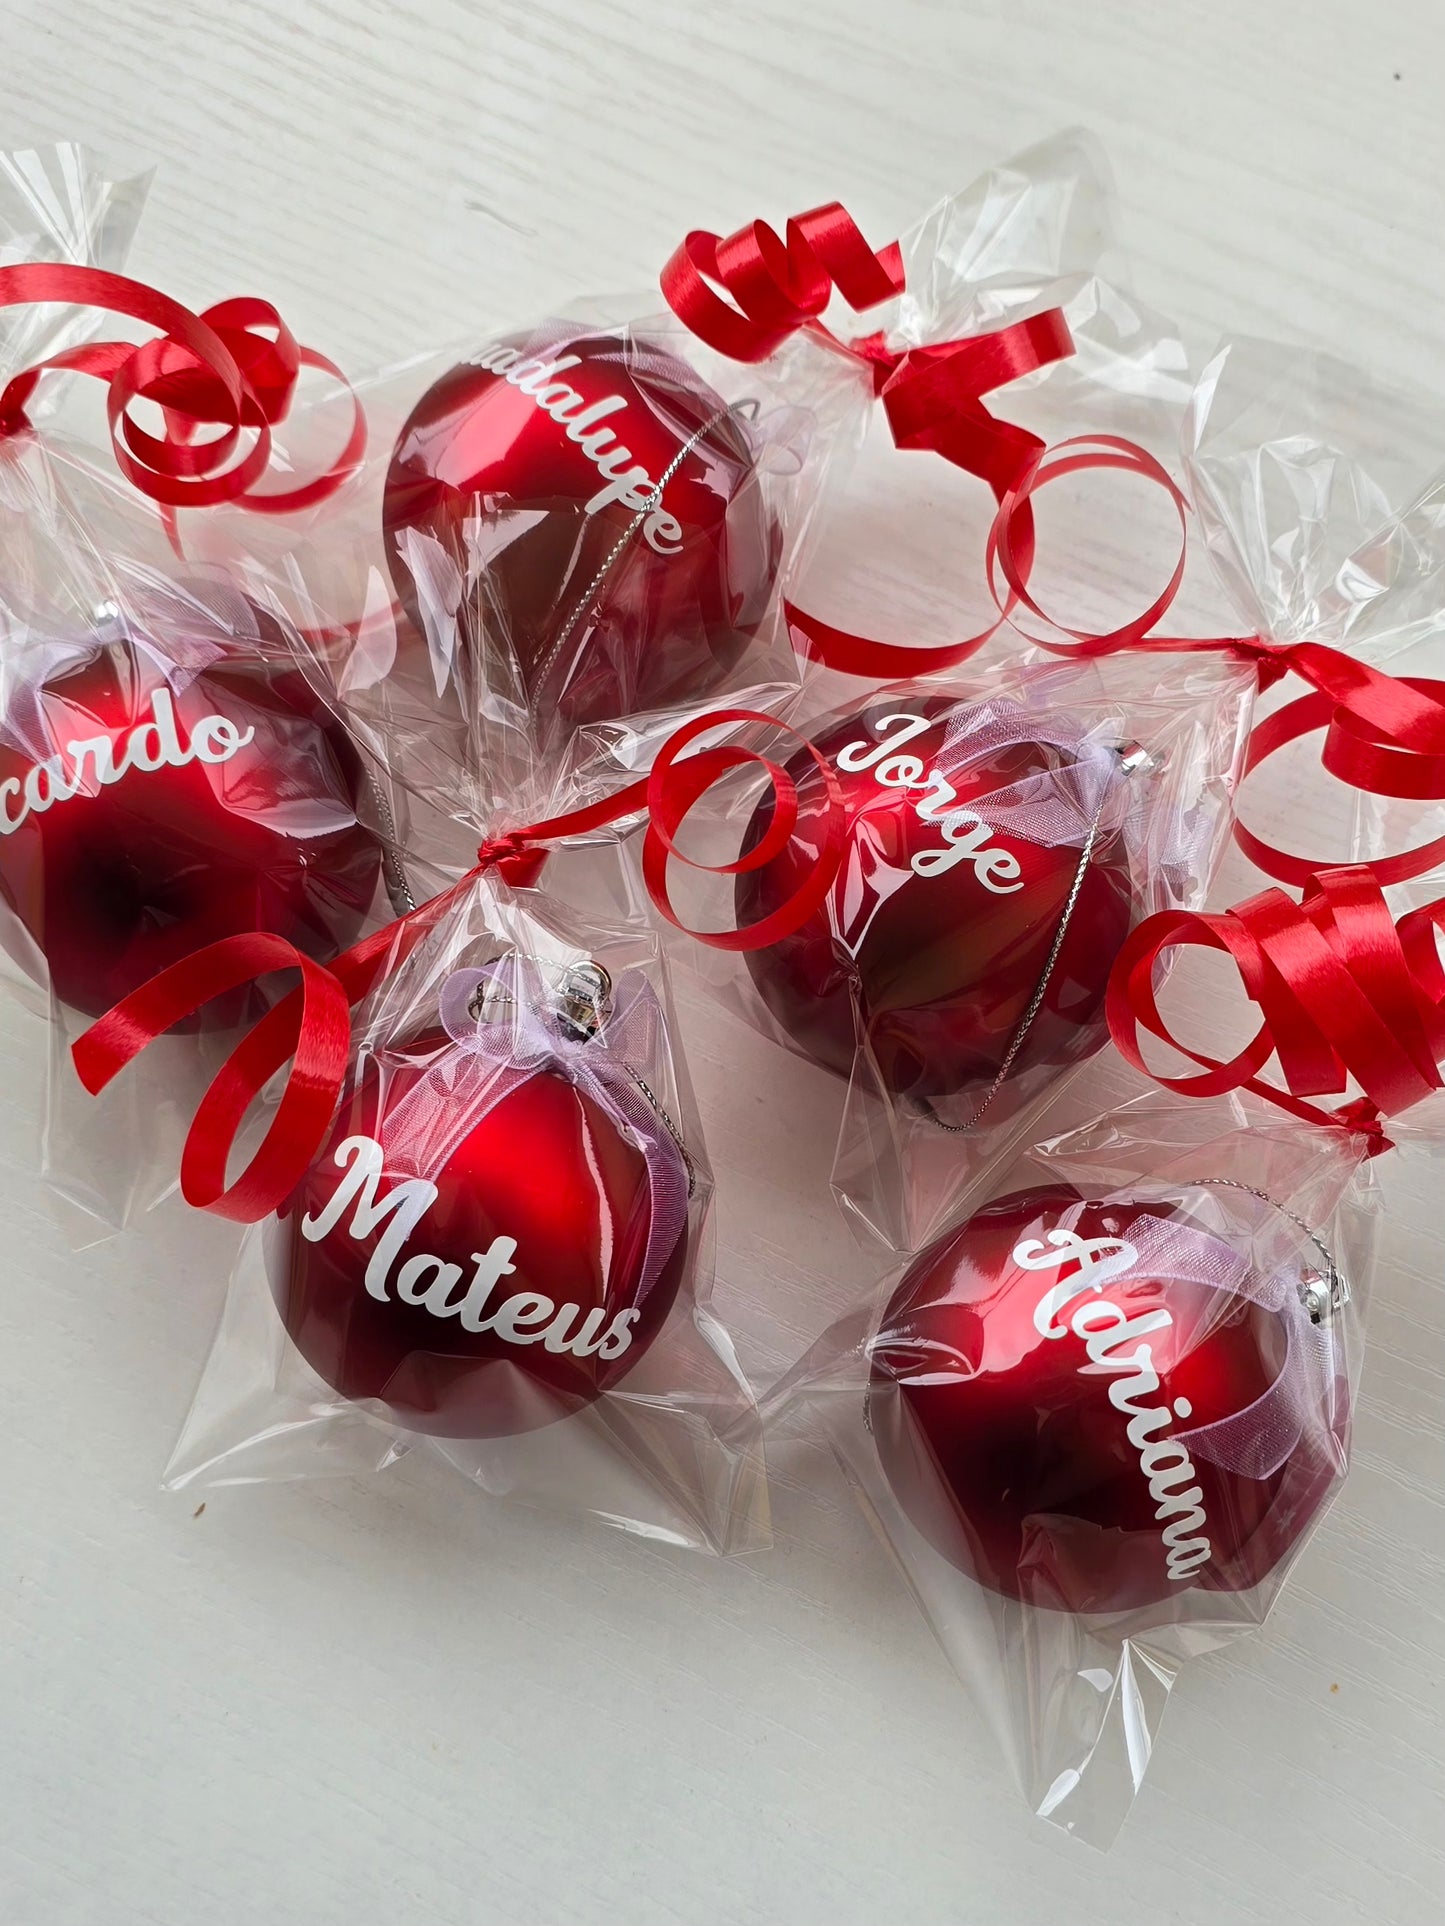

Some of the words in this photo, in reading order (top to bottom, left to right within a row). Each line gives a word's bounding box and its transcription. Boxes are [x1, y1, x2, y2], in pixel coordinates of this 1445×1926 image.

[836, 713, 1025, 894] Jorge
[301, 1135, 641, 1360] Mateus
[1012, 1229, 1212, 1580] Adriana
